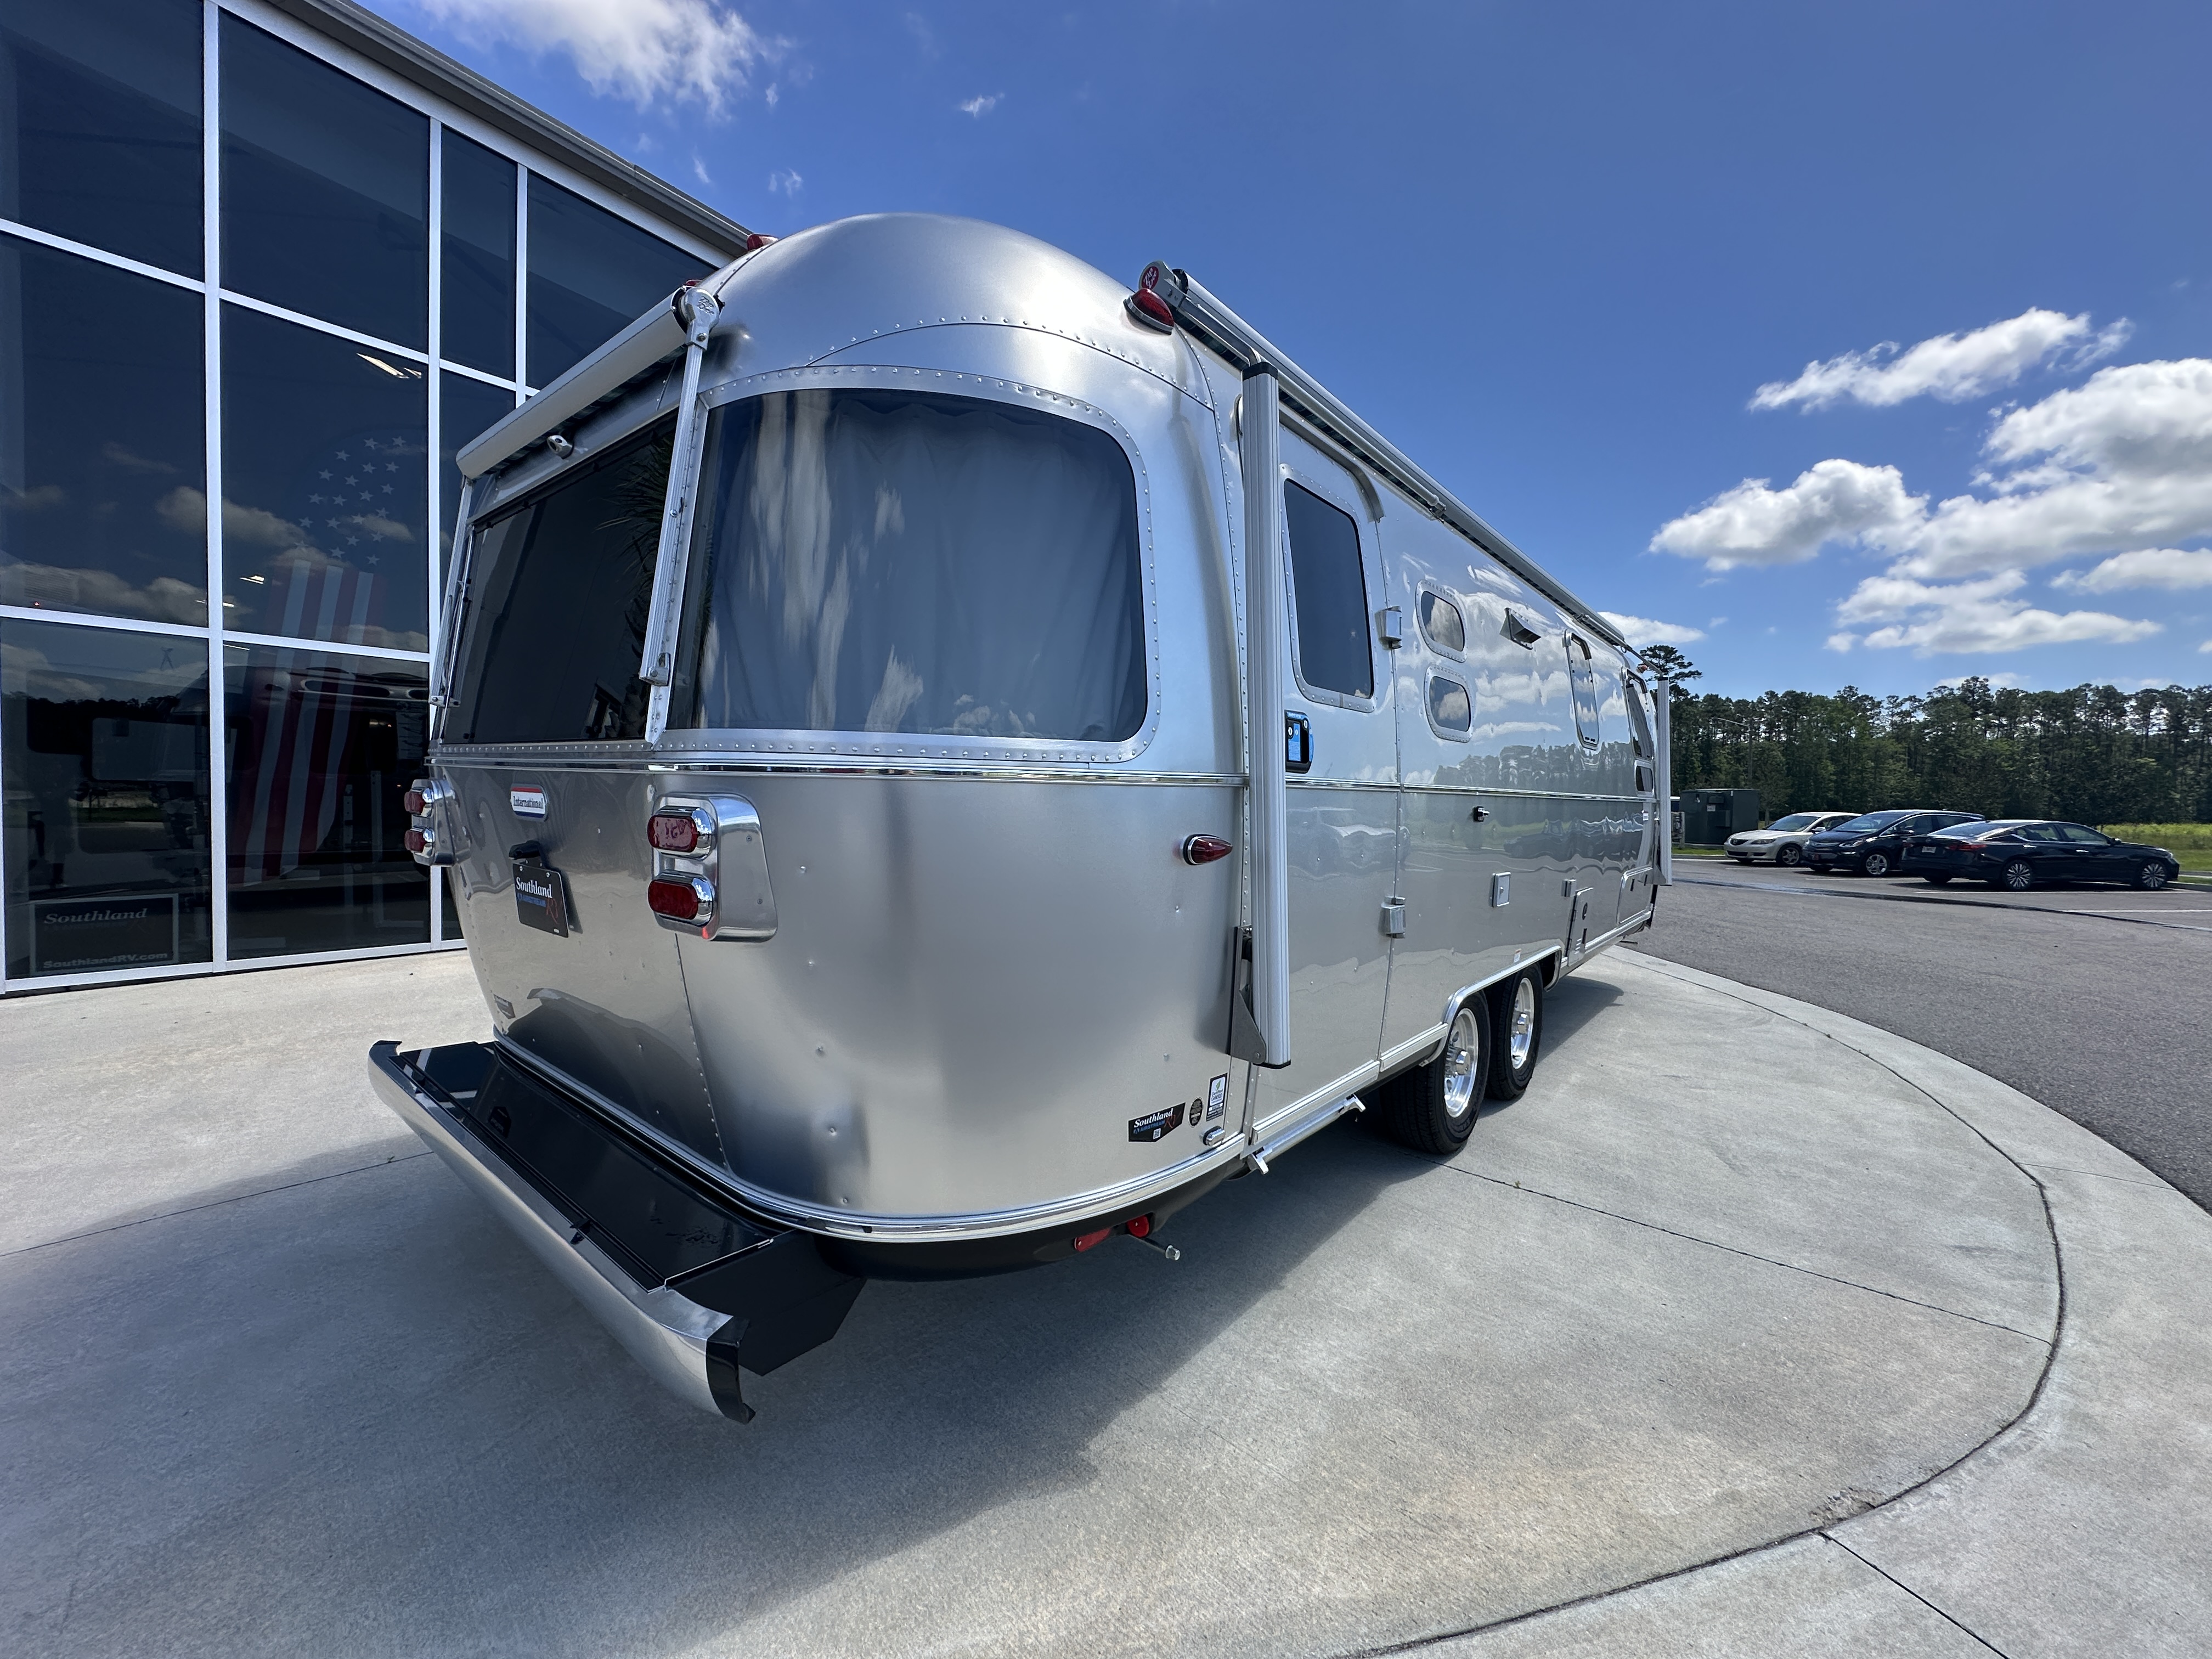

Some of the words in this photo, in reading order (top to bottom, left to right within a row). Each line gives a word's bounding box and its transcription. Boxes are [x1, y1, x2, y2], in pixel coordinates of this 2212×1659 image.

[513, 795, 544, 809] International
[516, 877, 553, 899] Southland
[44, 908, 148, 924] Southland
[43, 952, 167, 968] SouthlandRV.com
[1133, 1108, 1173, 1128] Southland
